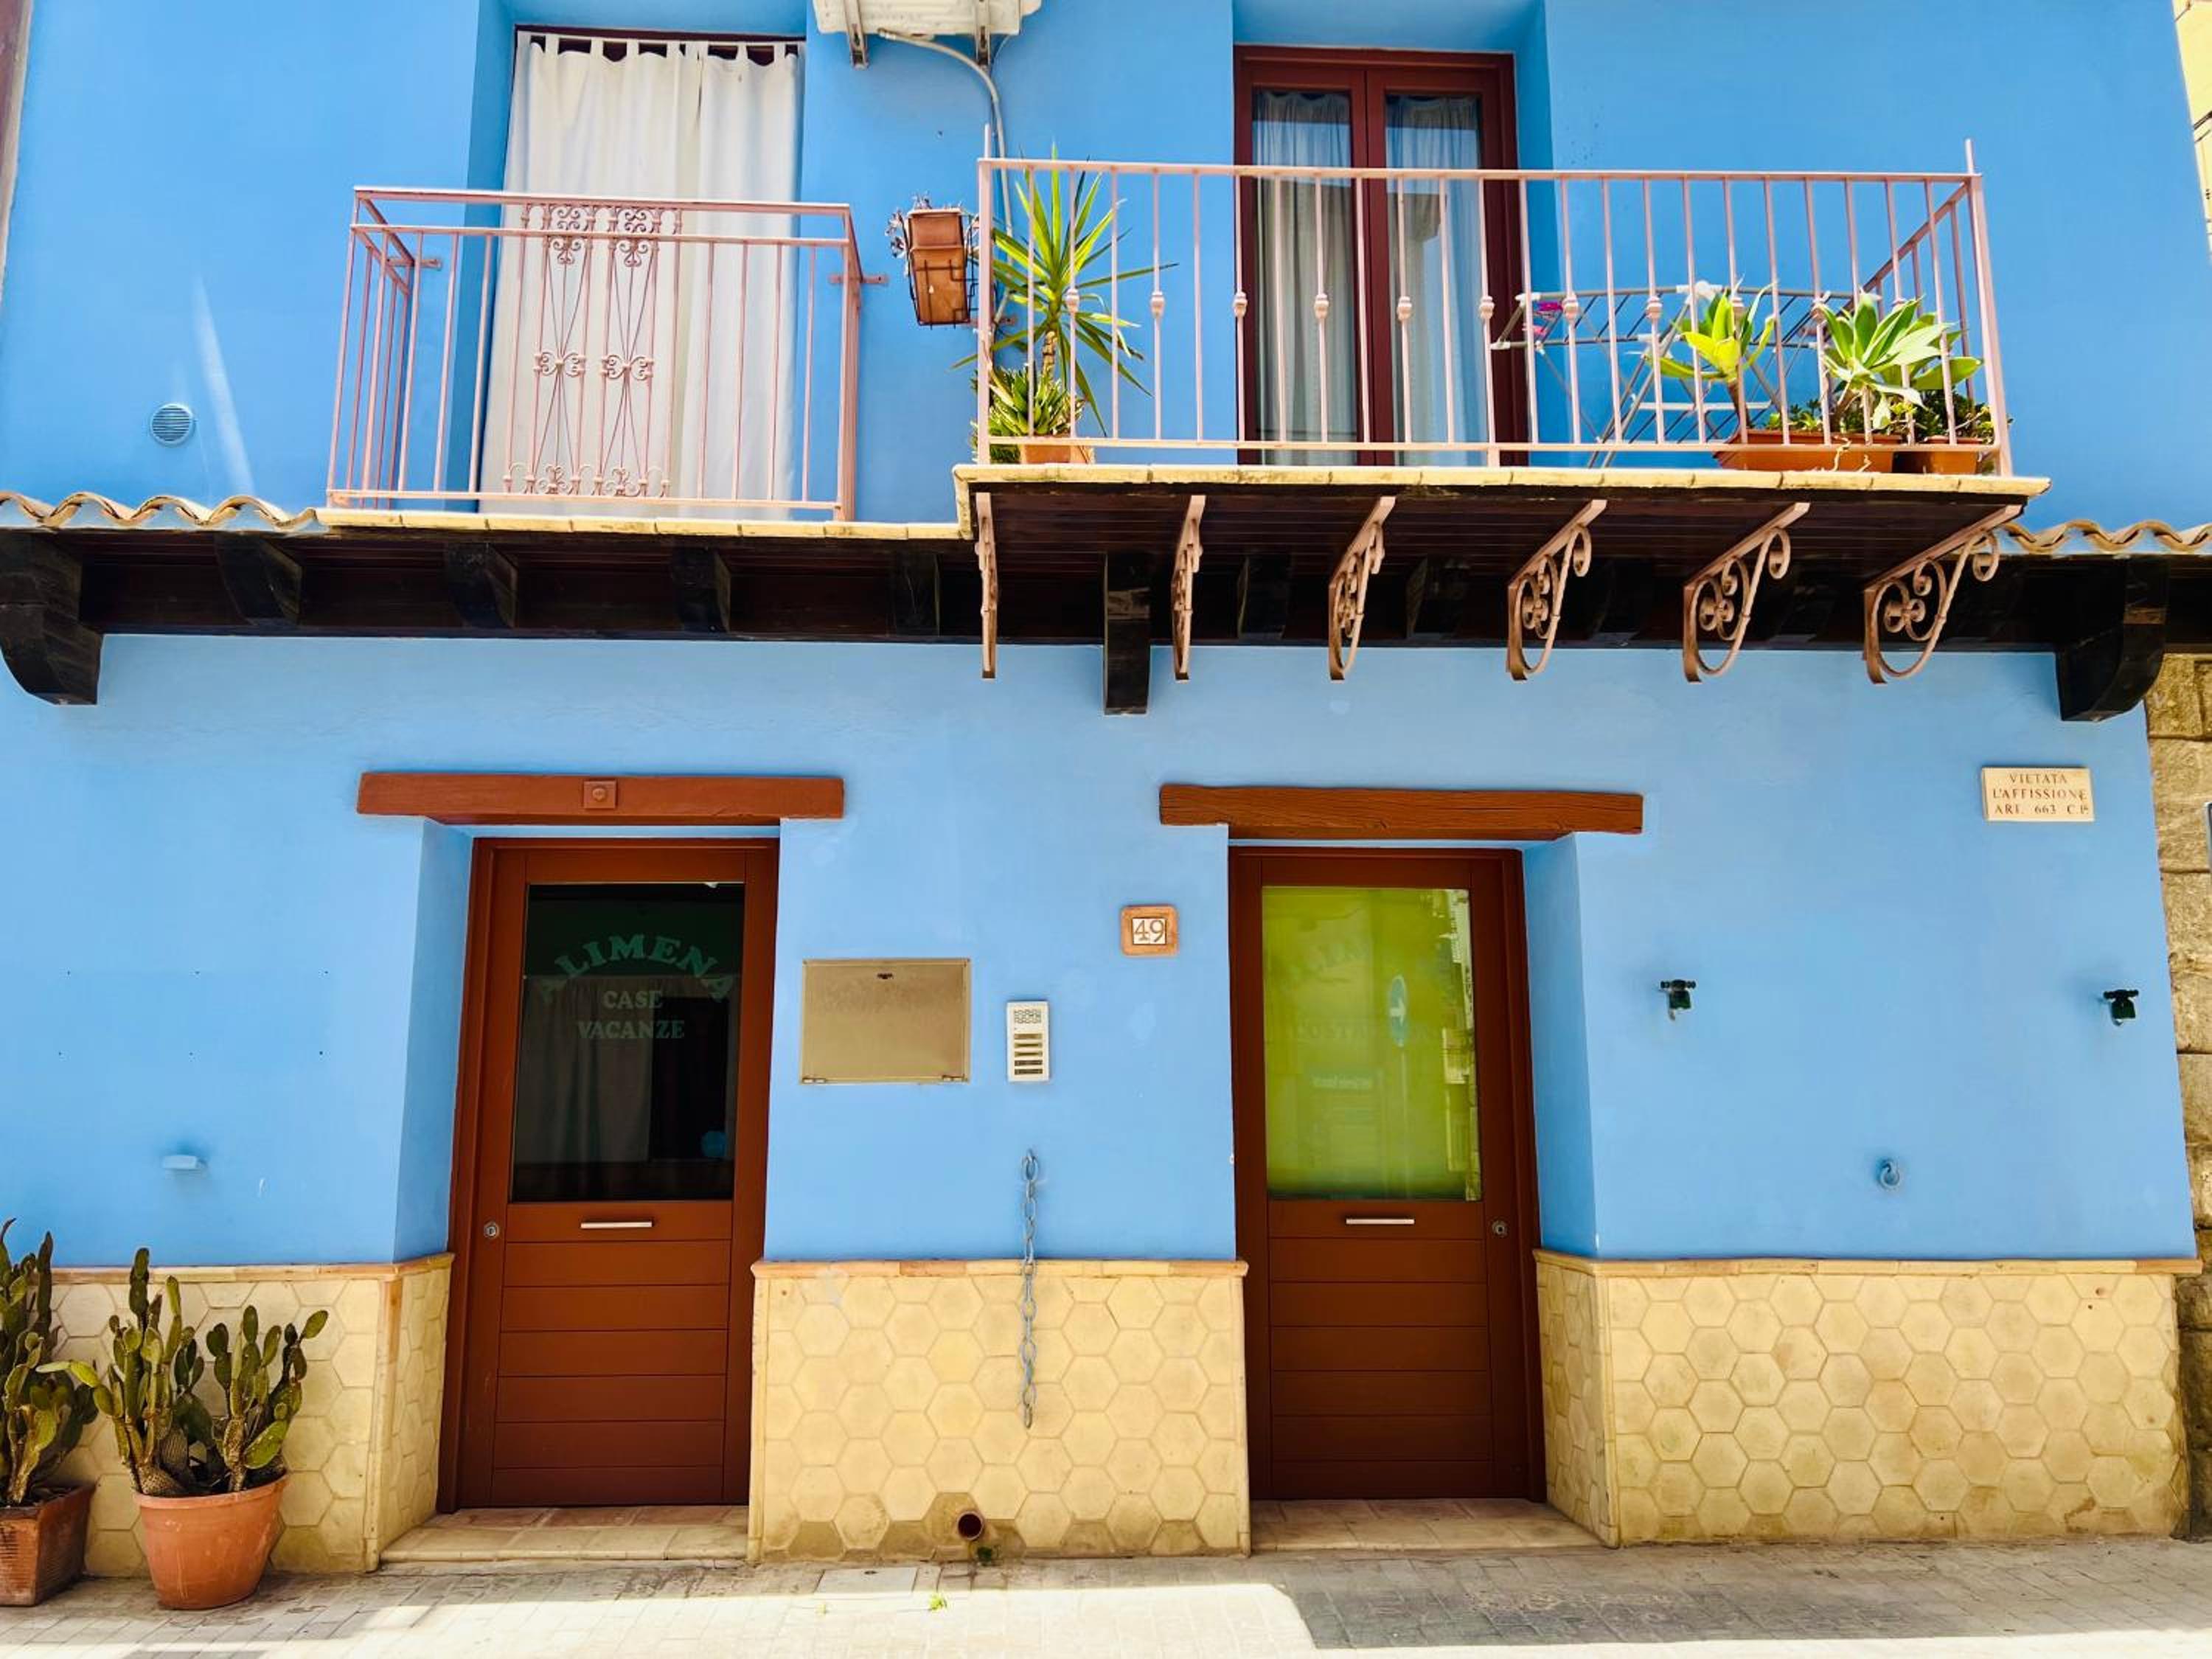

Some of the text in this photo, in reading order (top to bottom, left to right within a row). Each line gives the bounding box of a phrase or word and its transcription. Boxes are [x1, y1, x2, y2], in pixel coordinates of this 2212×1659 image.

[2009, 773, 2067, 785] VIETATA
[1993, 788, 2087, 801] L'AFFISSIONE
[2034, 804, 2056, 815] 663
[1135, 919, 1164, 942] 49
[603, 990, 663, 1010] CASE
[577, 1020, 685, 1039] VACANZE
